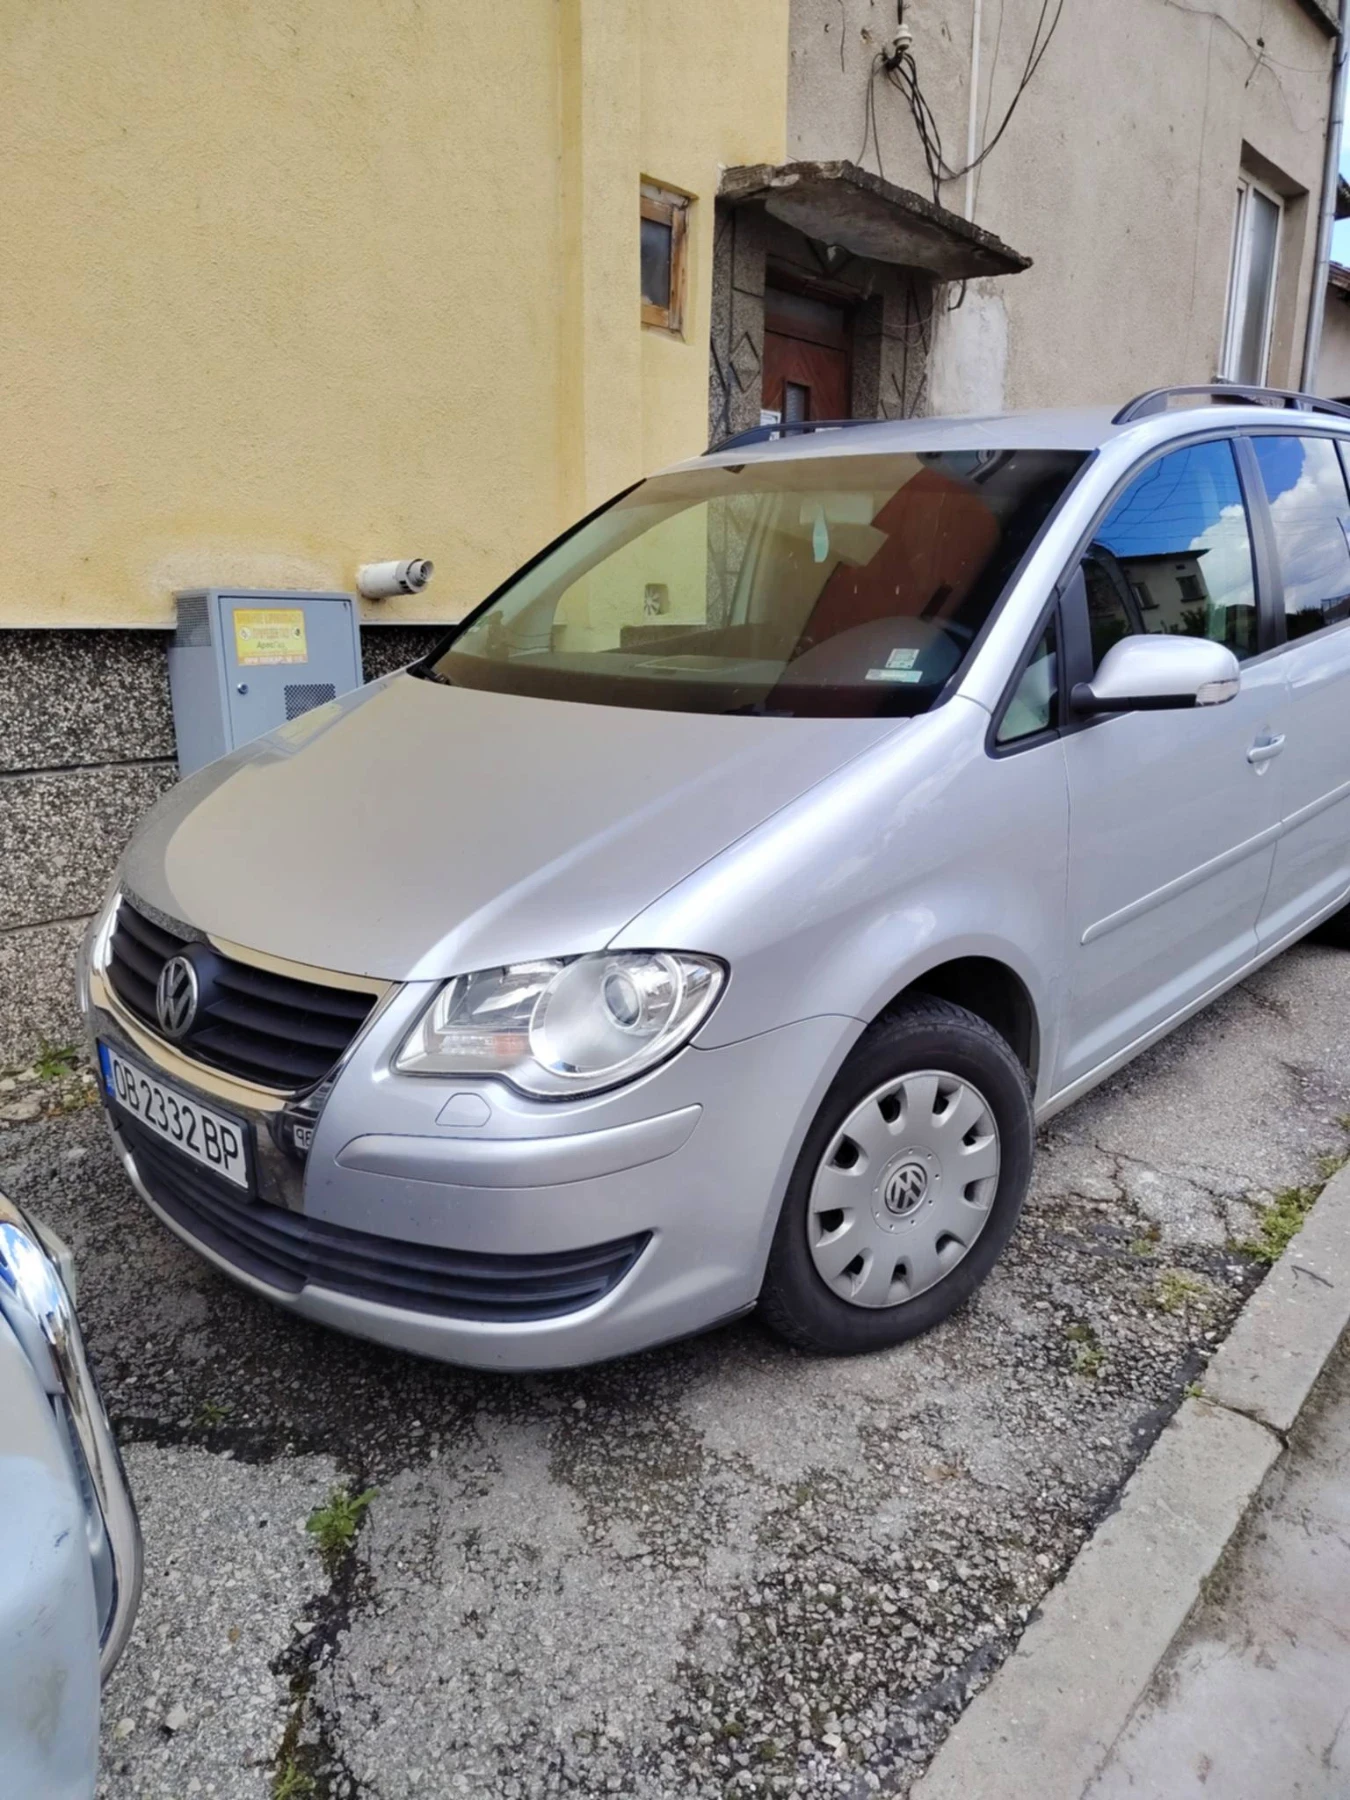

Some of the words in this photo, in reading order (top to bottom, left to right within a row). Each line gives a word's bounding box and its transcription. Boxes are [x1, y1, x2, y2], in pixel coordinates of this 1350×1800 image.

[157, 956, 198, 1037] VW
[140, 1080, 200, 1153] 2332
[202, 1115, 239, 1171] BP
[884, 1162, 928, 1216] VW
